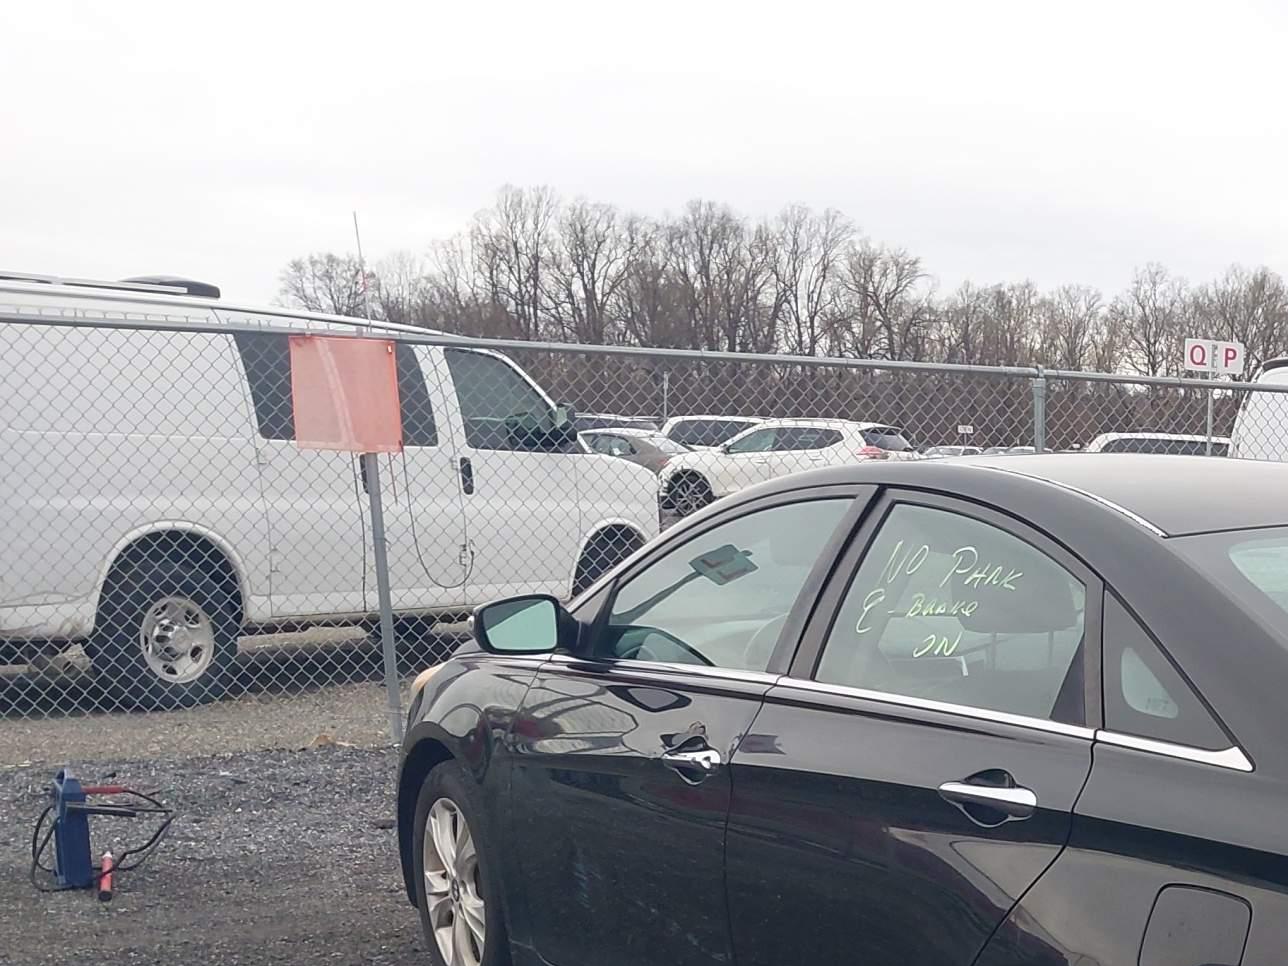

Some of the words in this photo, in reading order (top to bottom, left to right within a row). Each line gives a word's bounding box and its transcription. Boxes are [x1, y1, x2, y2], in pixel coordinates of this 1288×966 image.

[1190, 345, 1207, 366] Q
[1224, 348, 1237, 368] P
[876, 540, 929, 588] NO
[912, 631, 963, 658] ON
